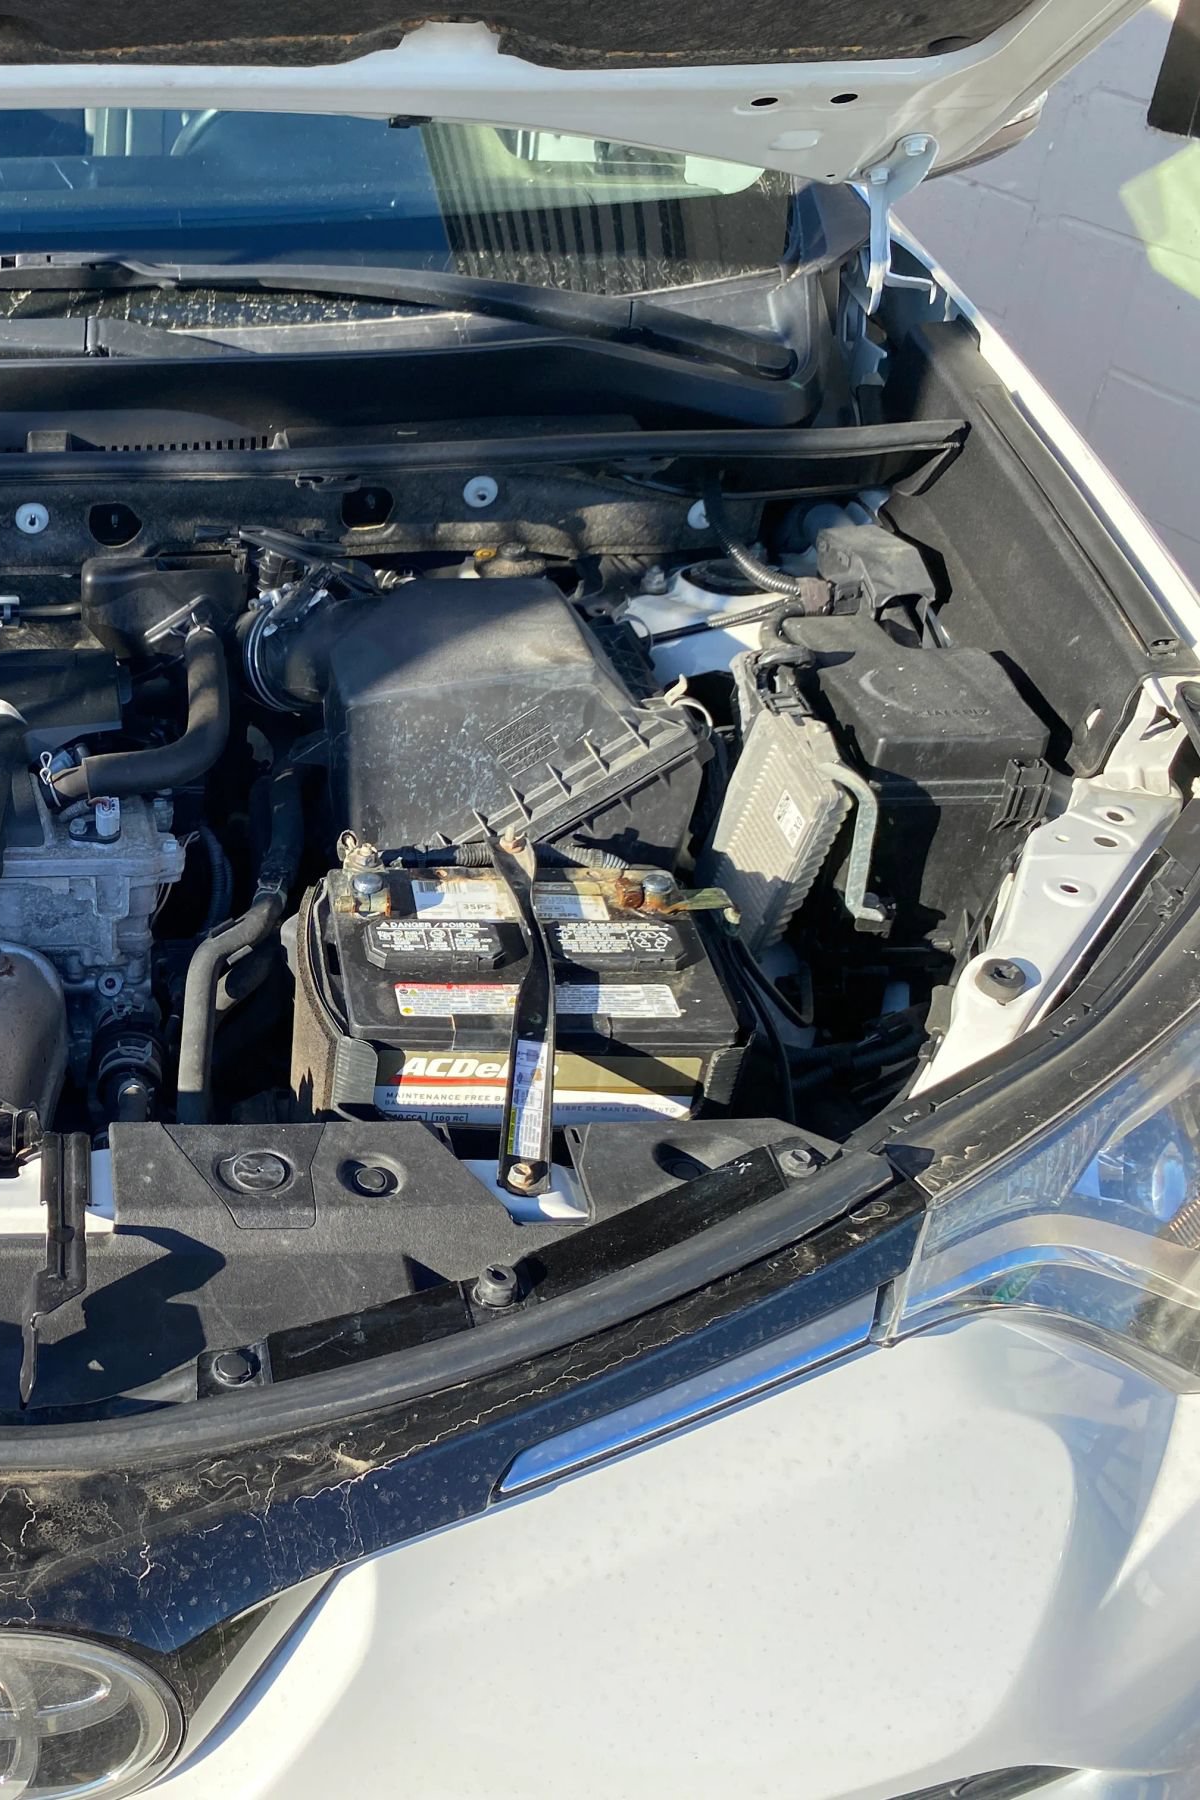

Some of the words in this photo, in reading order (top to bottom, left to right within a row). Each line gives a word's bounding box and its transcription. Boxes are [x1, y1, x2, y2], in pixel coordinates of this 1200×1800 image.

[386, 1092, 461, 1101] MAINTENANCE
[464, 1094, 491, 1102] FREE
[600, 1106, 676, 1114] MANTENIMIENTO
